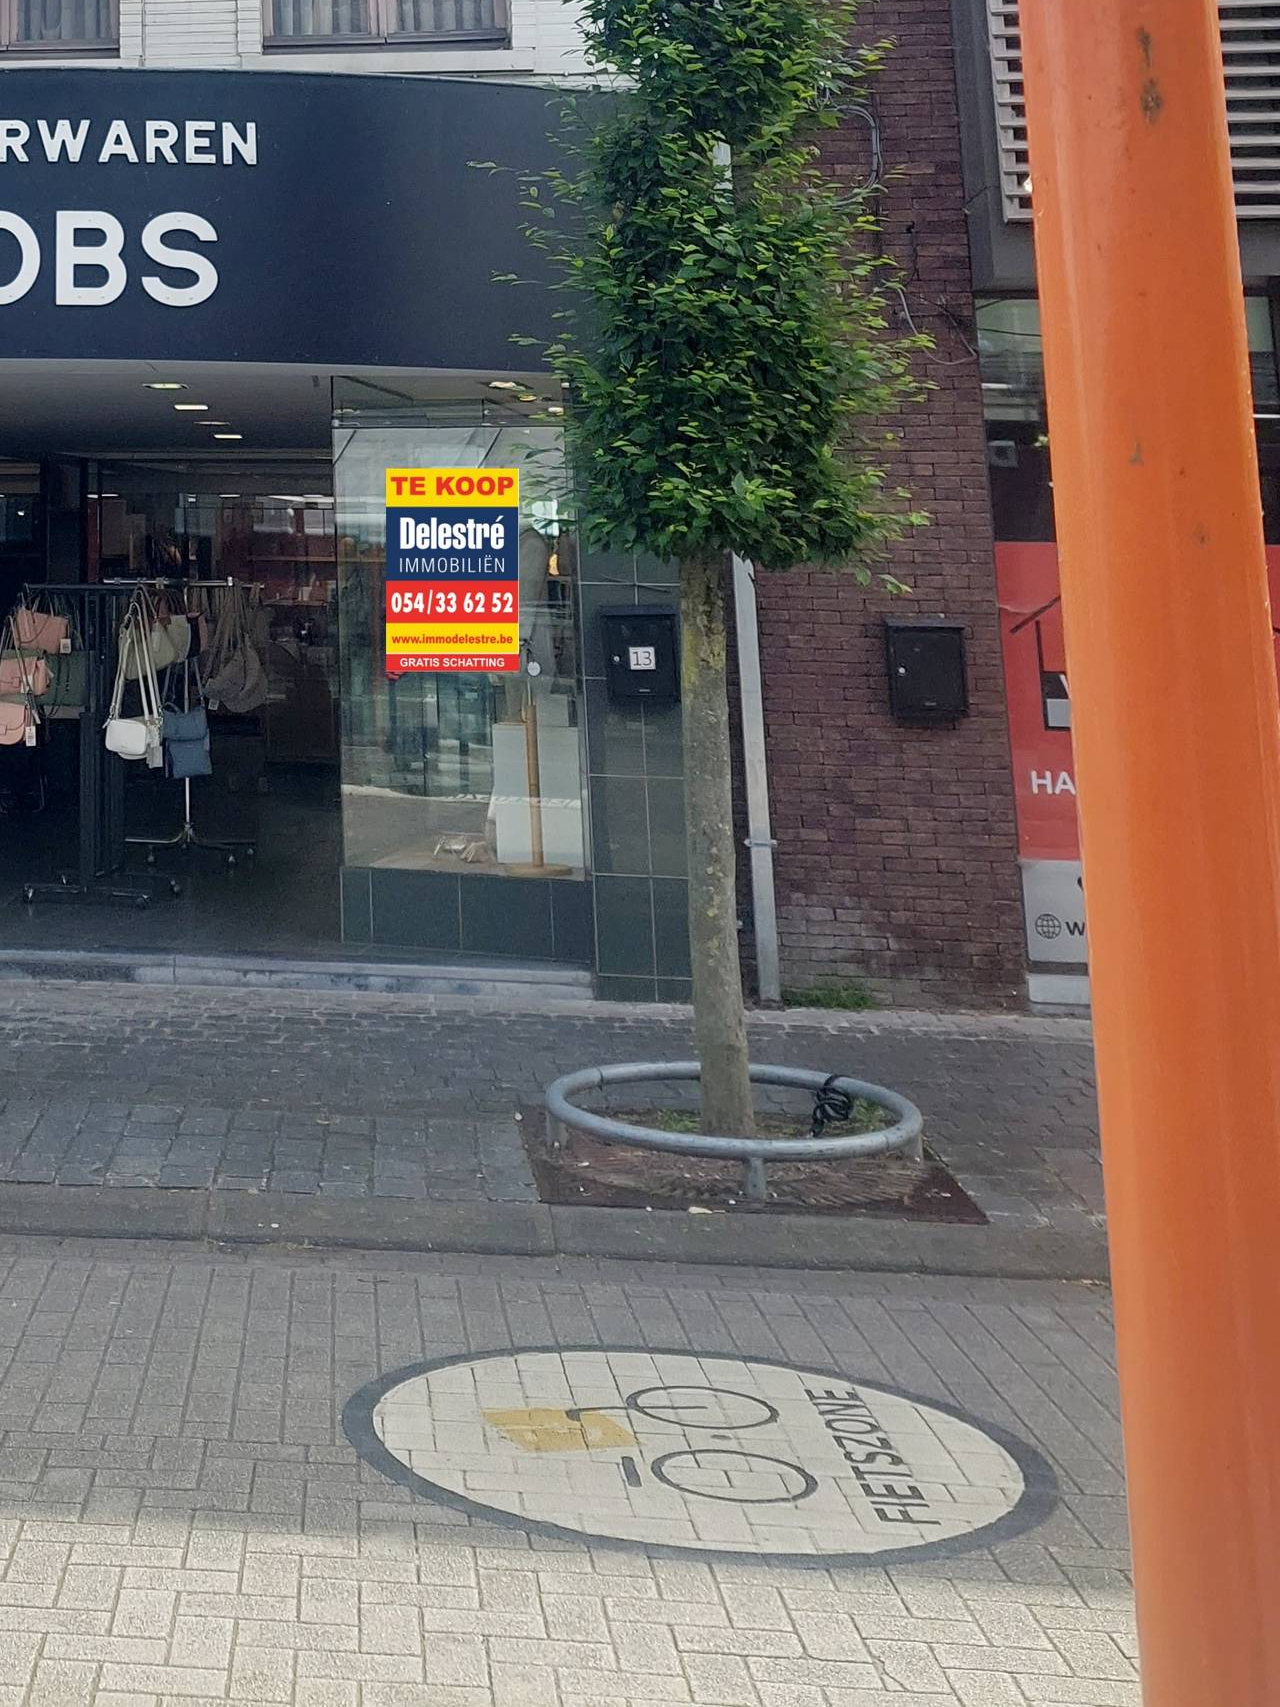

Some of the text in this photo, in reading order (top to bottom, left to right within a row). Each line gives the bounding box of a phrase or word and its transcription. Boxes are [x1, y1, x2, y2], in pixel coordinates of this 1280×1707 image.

[390, 476, 514, 496] TE KOOP
[399, 515, 505, 550] Delestré
[399, 554, 505, 573] IMMOBILIËN
[391, 589, 513, 615] 054/33 62 52
[391, 633, 513, 644] www.immodelestre.be
[399, 657, 505, 668] GRATIS SCHATTING
[632, 650, 652, 666] 13
[804, 1388, 942, 1526] FIETSZONE
